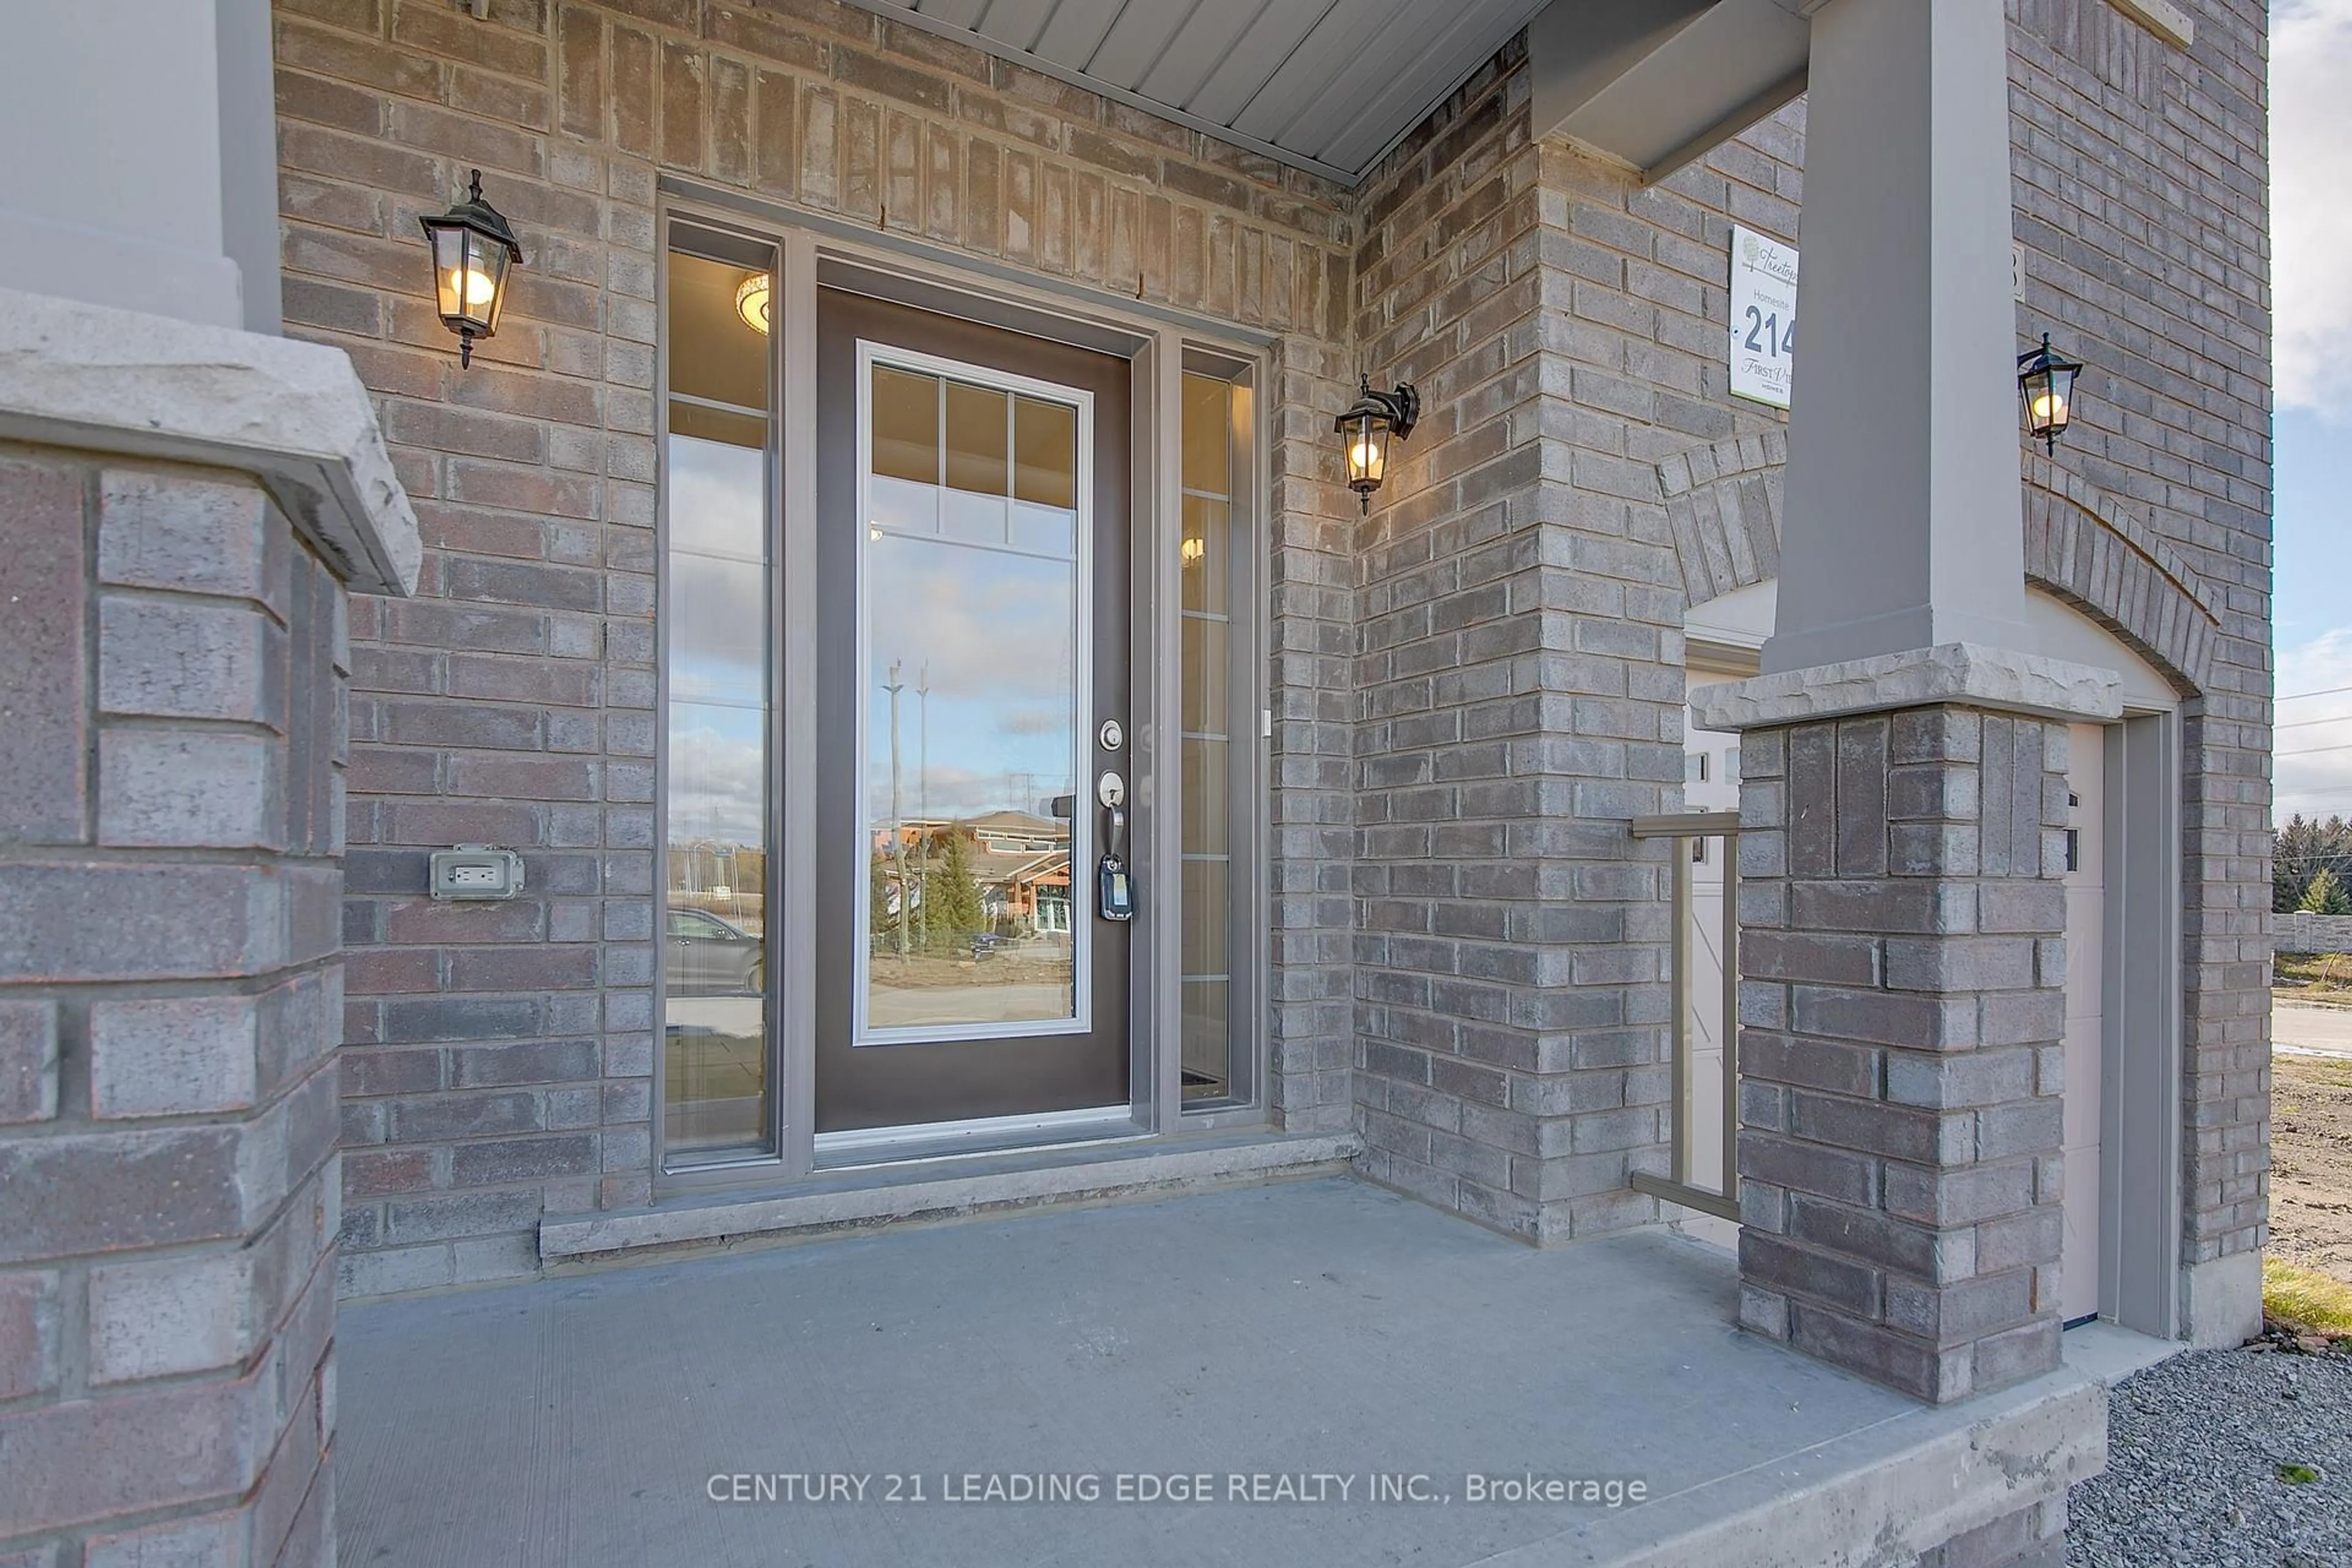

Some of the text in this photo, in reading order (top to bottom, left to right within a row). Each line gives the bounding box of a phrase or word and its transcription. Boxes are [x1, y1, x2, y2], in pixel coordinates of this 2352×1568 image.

[1760, 247, 1798, 288] Treetop
[1754, 288, 1790, 311] Homesite
[1744, 305, 1795, 358] 214
[1741, 357, 1773, 379] FIRST
